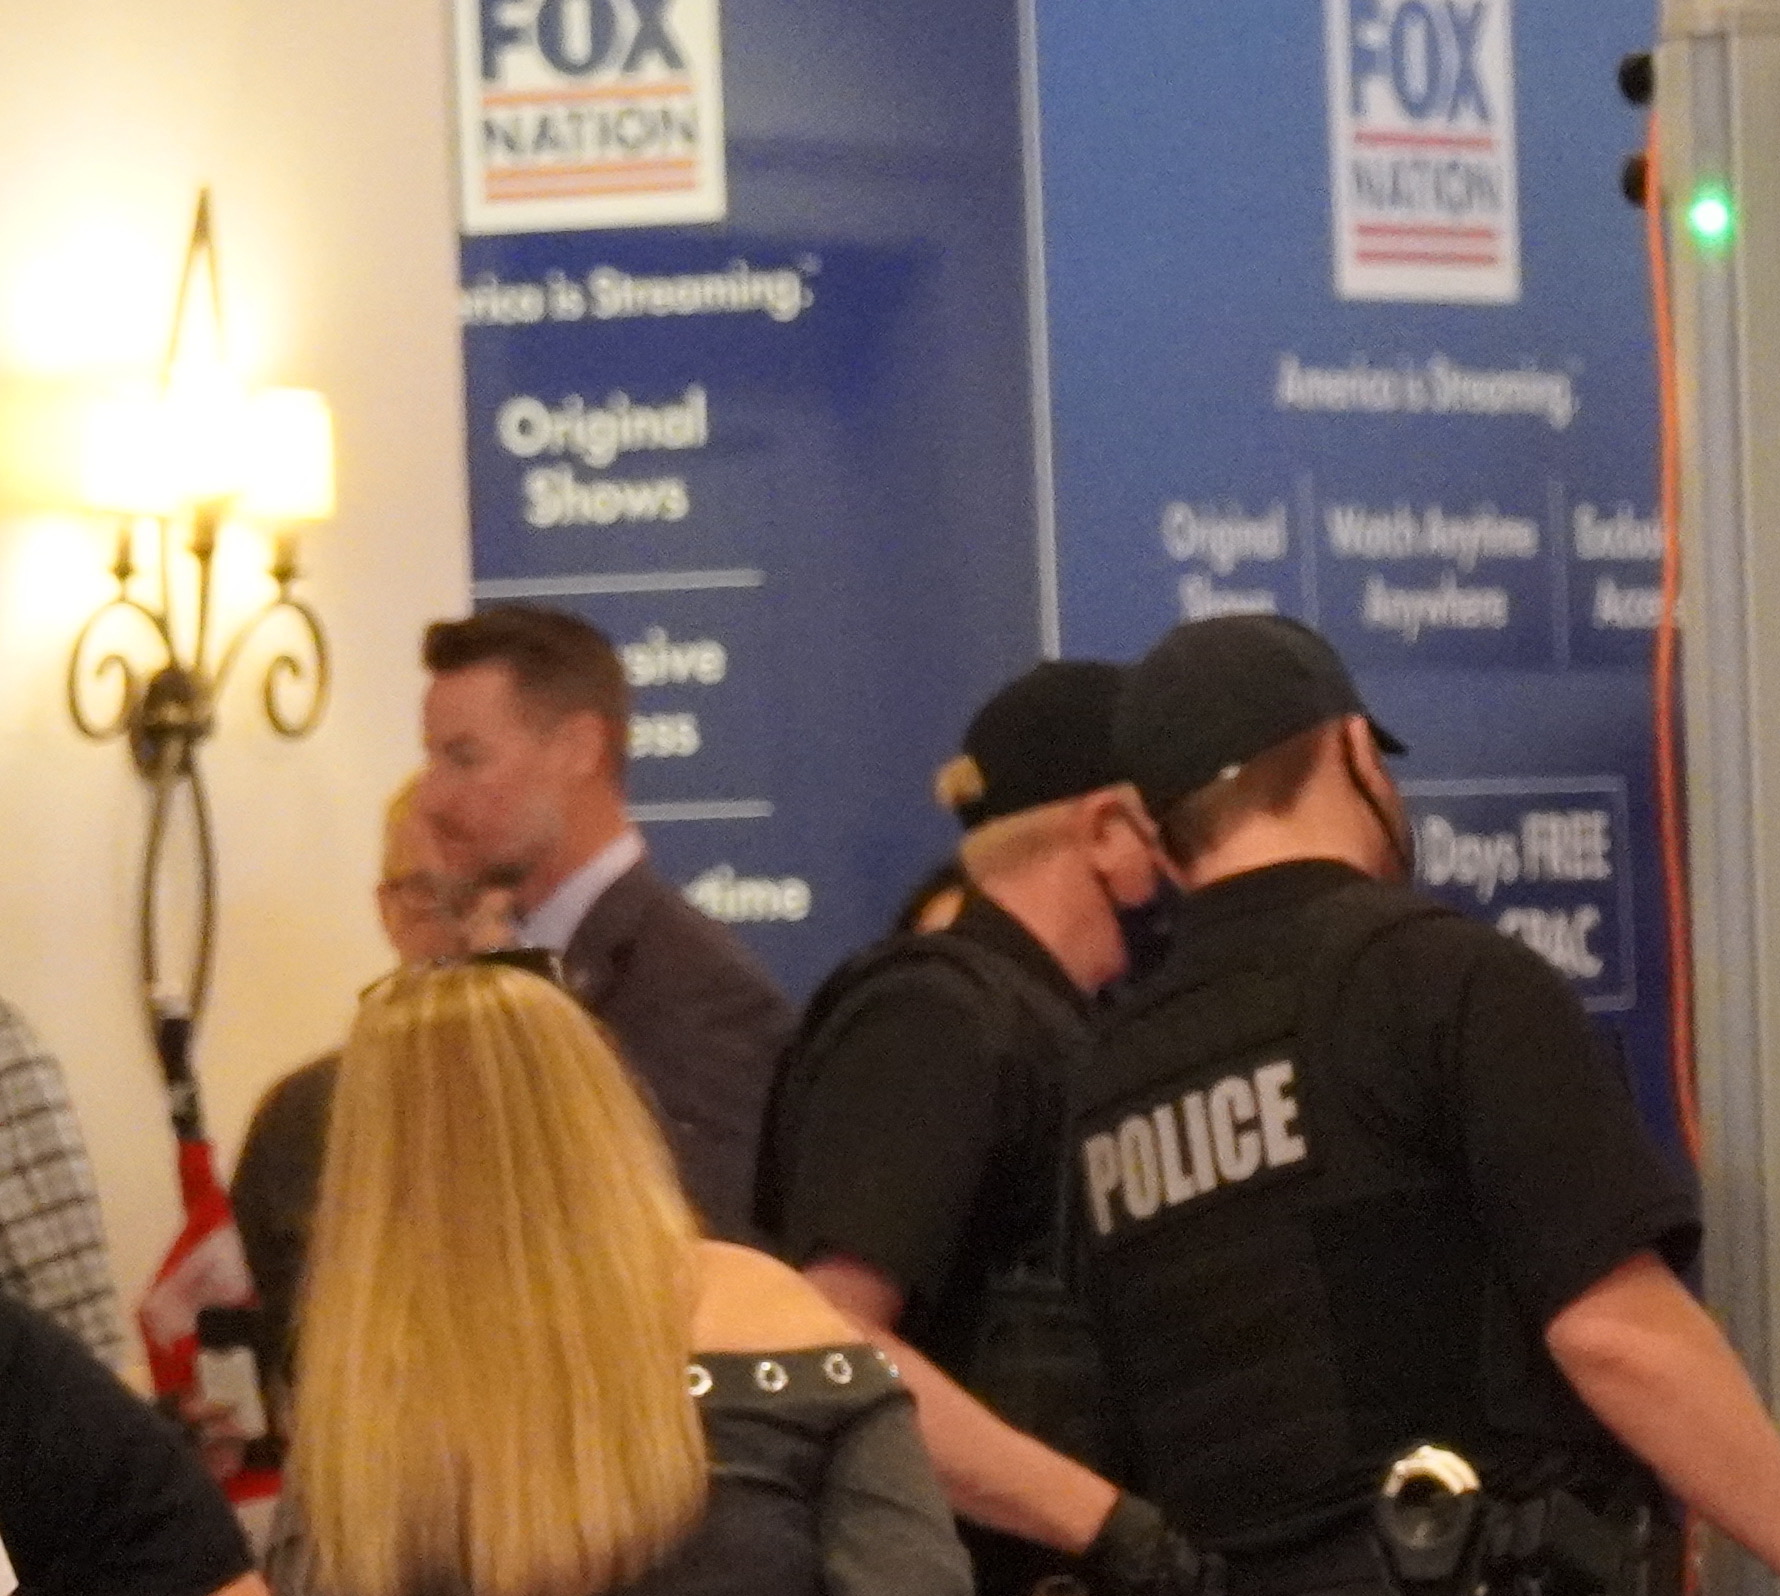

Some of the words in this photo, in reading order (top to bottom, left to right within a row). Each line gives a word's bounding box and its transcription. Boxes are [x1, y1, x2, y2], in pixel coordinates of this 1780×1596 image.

[480, 0, 684, 79] FOX
[1350, 1, 1491, 121] FOX
[480, 107, 698, 158] NATION
[1352, 158, 1501, 213] NATION
[1276, 351, 1393, 410] America
[498, 384, 711, 468] Original
[524, 464, 690, 528] Shows
[1161, 499, 1288, 575] Original
[1326, 504, 1419, 558] Watch
[1425, 504, 1540, 570] Anytime
[1362, 570, 1509, 644] Anywhere
[1420, 813, 1521, 904] Days
[1521, 809, 1613, 881] FREE
[1083, 1058, 1308, 1235] POLICE
